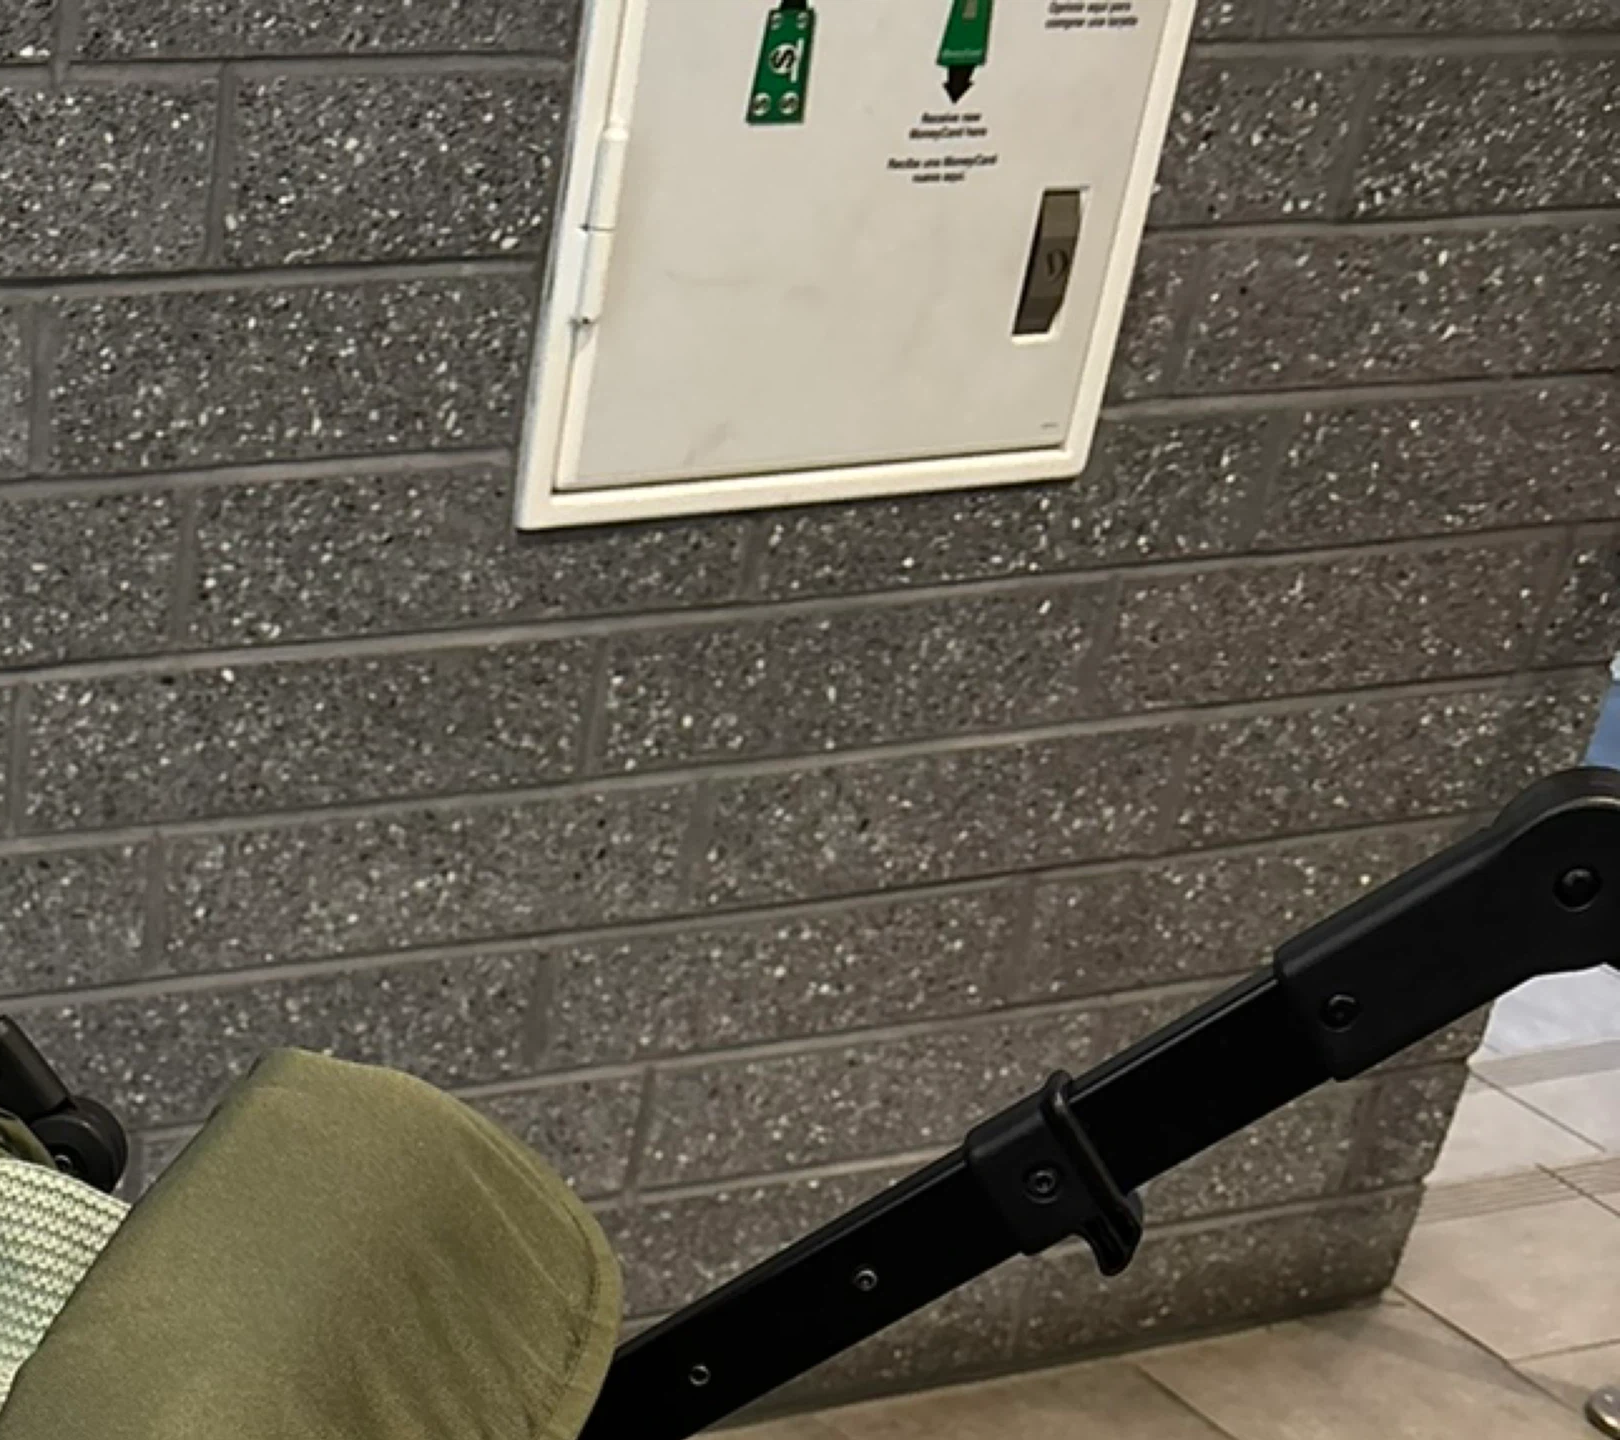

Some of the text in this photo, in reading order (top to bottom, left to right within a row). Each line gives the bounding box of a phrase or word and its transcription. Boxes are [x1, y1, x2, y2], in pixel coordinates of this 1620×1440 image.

[921, 112, 959, 123] Receive
[909, 126, 988, 140] MoneyCard here
[944, 153, 998, 168] MoneyCard
